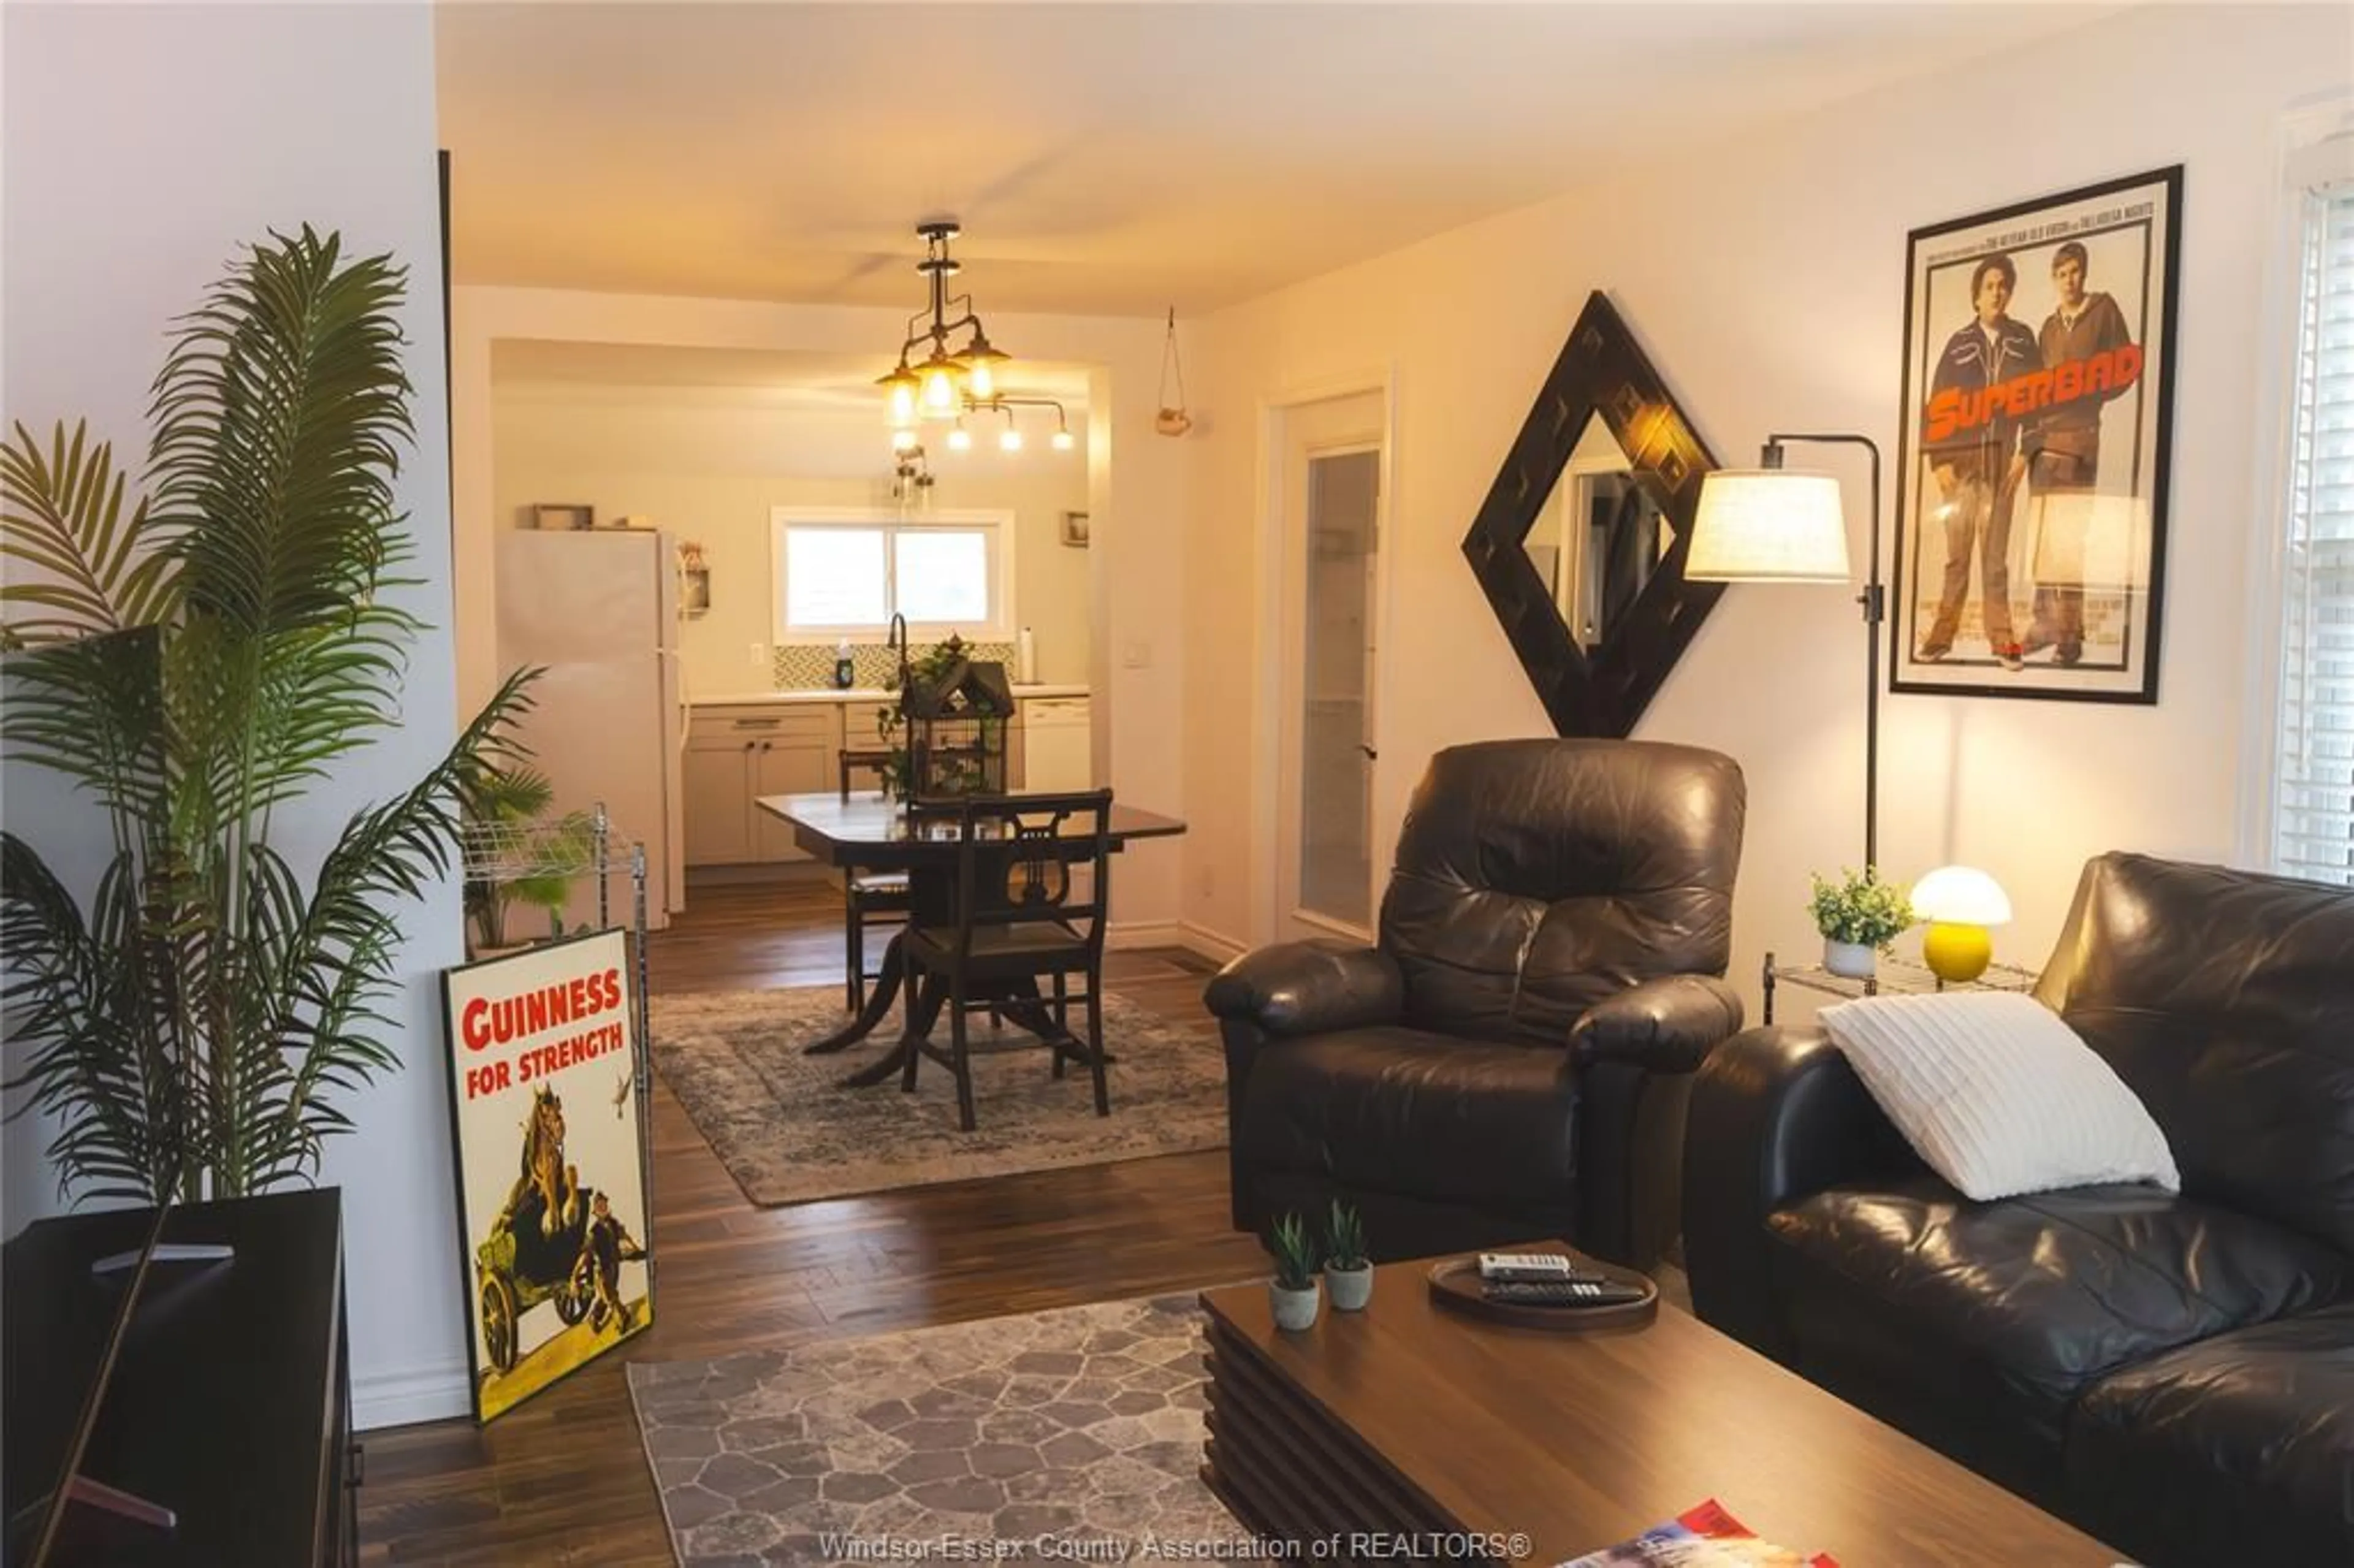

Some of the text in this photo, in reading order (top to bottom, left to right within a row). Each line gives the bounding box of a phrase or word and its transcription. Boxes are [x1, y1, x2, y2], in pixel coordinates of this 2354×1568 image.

[1925, 342, 2143, 443] SUPERBAD
[462, 969, 622, 1051] GUINNESS
[467, 1021, 623, 1100] FOR STRENGTH
